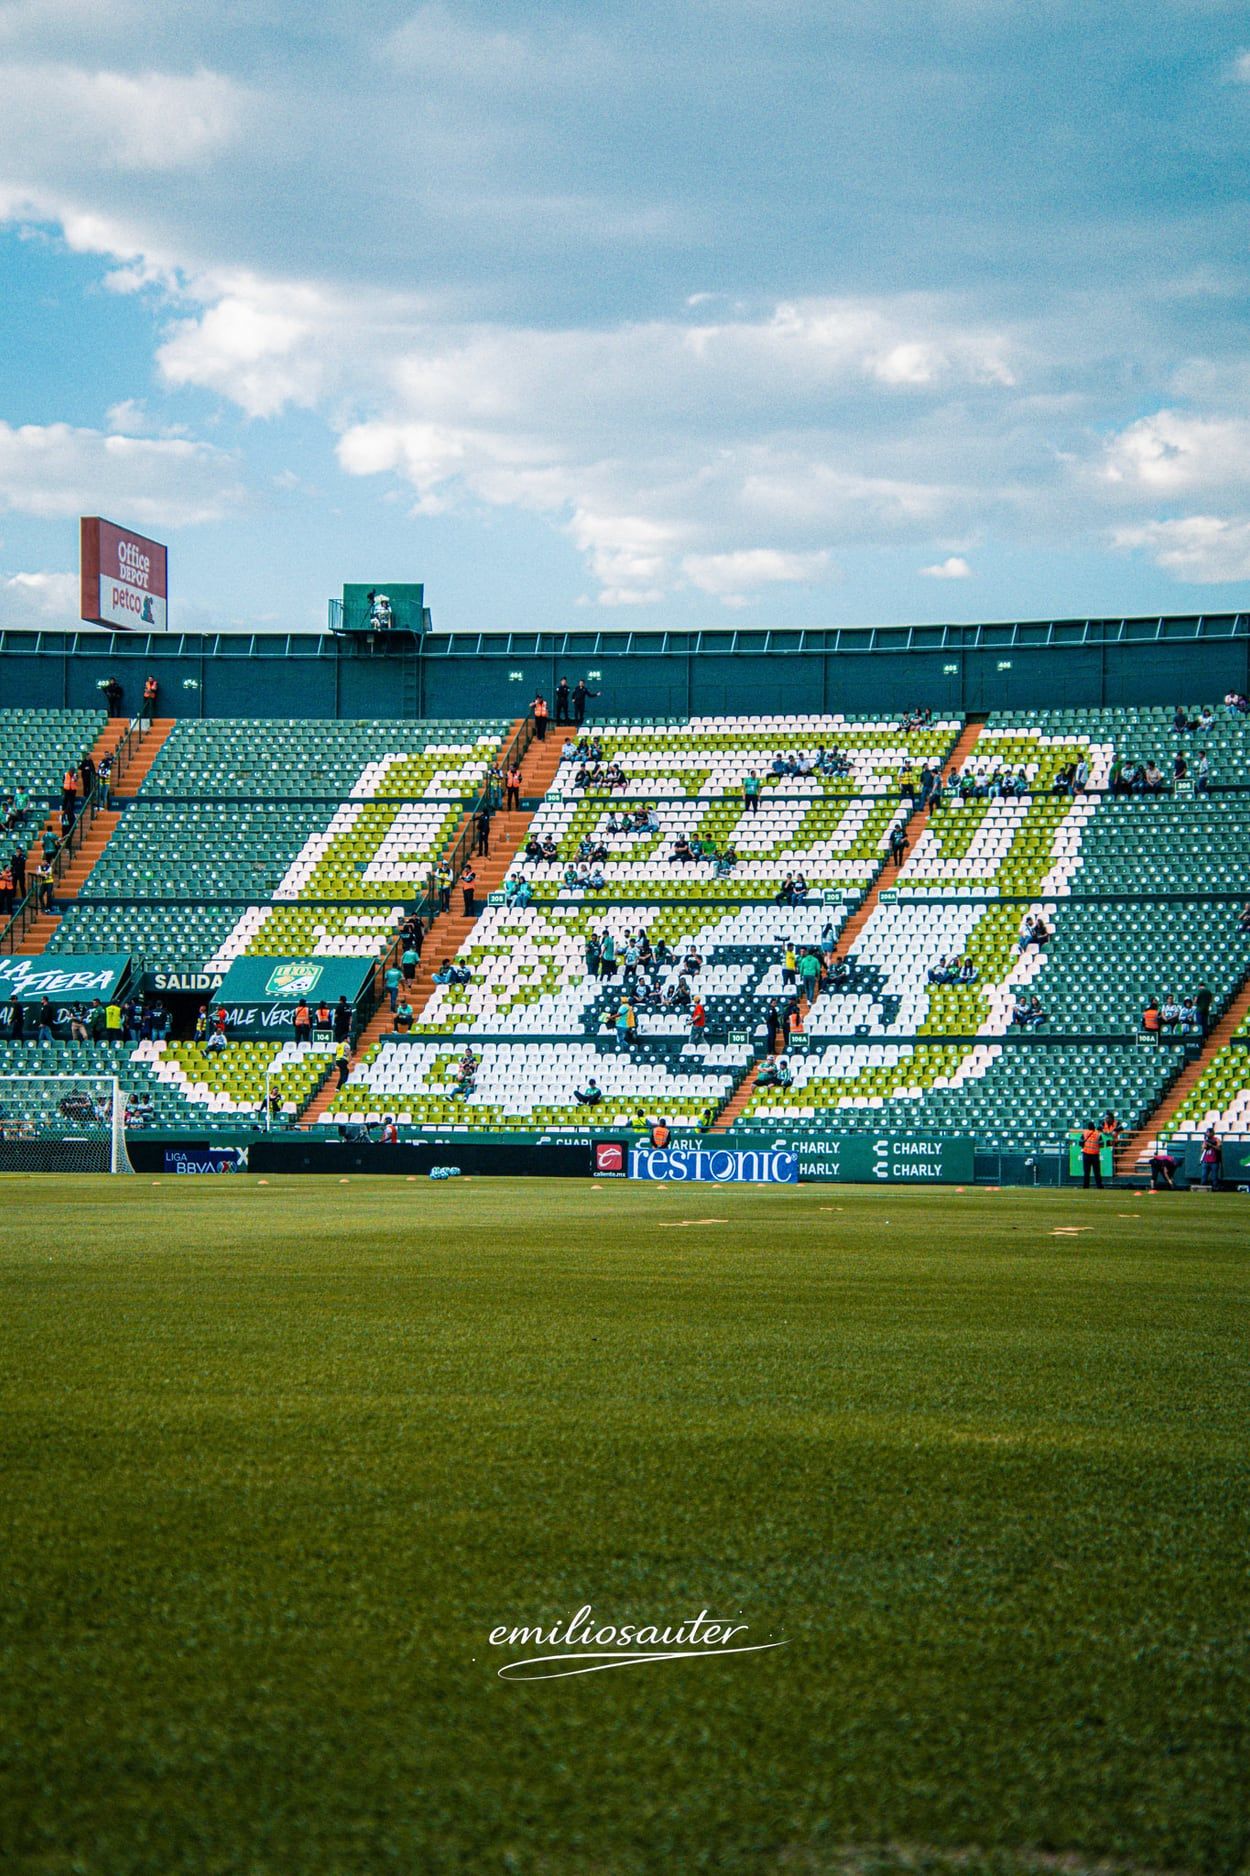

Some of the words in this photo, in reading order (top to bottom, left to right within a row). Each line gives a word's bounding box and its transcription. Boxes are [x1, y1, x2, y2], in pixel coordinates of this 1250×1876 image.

[118, 541, 149, 572] Office
[119, 562, 149, 588] DEPOT
[112, 586, 141, 613] petco
[10, 969, 116, 996] FIERA
[155, 974, 223, 989] SALIDA
[221, 1007, 259, 1026] ALE
[316, 1033, 330, 1041] 104
[732, 1034, 745, 1042] 105
[791, 1141, 840, 1154] CHARLY
[893, 1142, 942, 1155] CHARLY
[165, 1152, 188, 1162] LIGA
[176, 1161, 216, 1174] BBVA
[799, 1163, 840, 1175] HARLY
[893, 1164, 942, 1176] CHARLY
